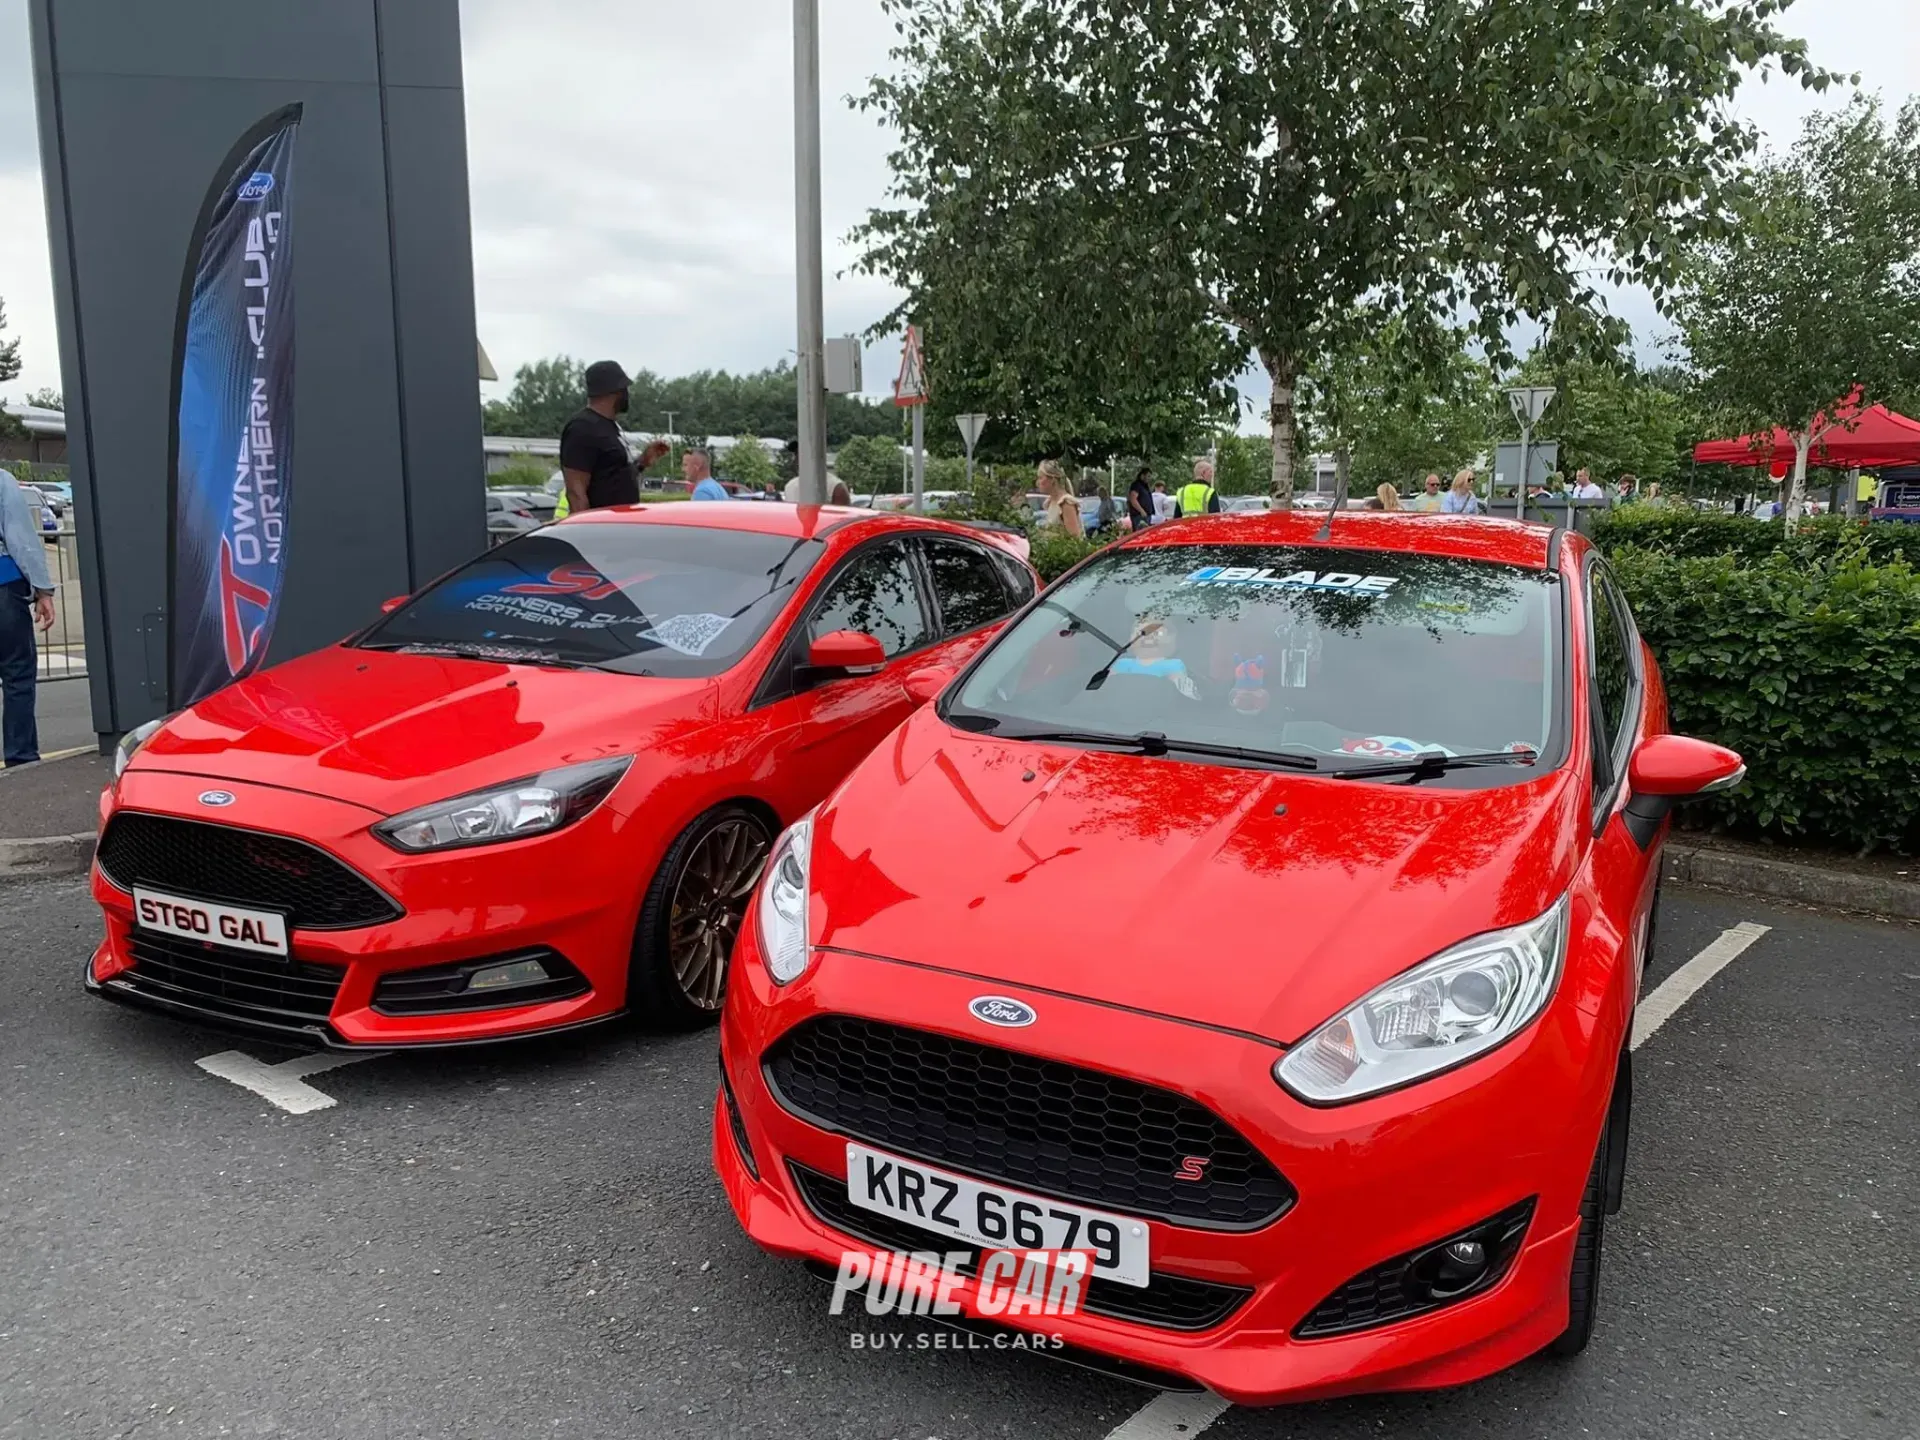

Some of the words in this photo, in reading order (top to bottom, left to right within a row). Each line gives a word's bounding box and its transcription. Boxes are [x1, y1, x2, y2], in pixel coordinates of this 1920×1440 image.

[250, 377, 283, 564] NORTHERN
[1179, 580, 1391, 599] PERFORMANCE
[1211, 566, 1400, 592] BLADE
[465, 602, 567, 627] NORTHERN
[476, 594, 584, 619] OWNERS
[139, 898, 209, 935] ST60
[219, 915, 279, 947] GAL
[981, 1001, 1020, 1021] Ford
[865, 1155, 960, 1228] KRZ
[976, 1191, 1120, 1269] 6679
